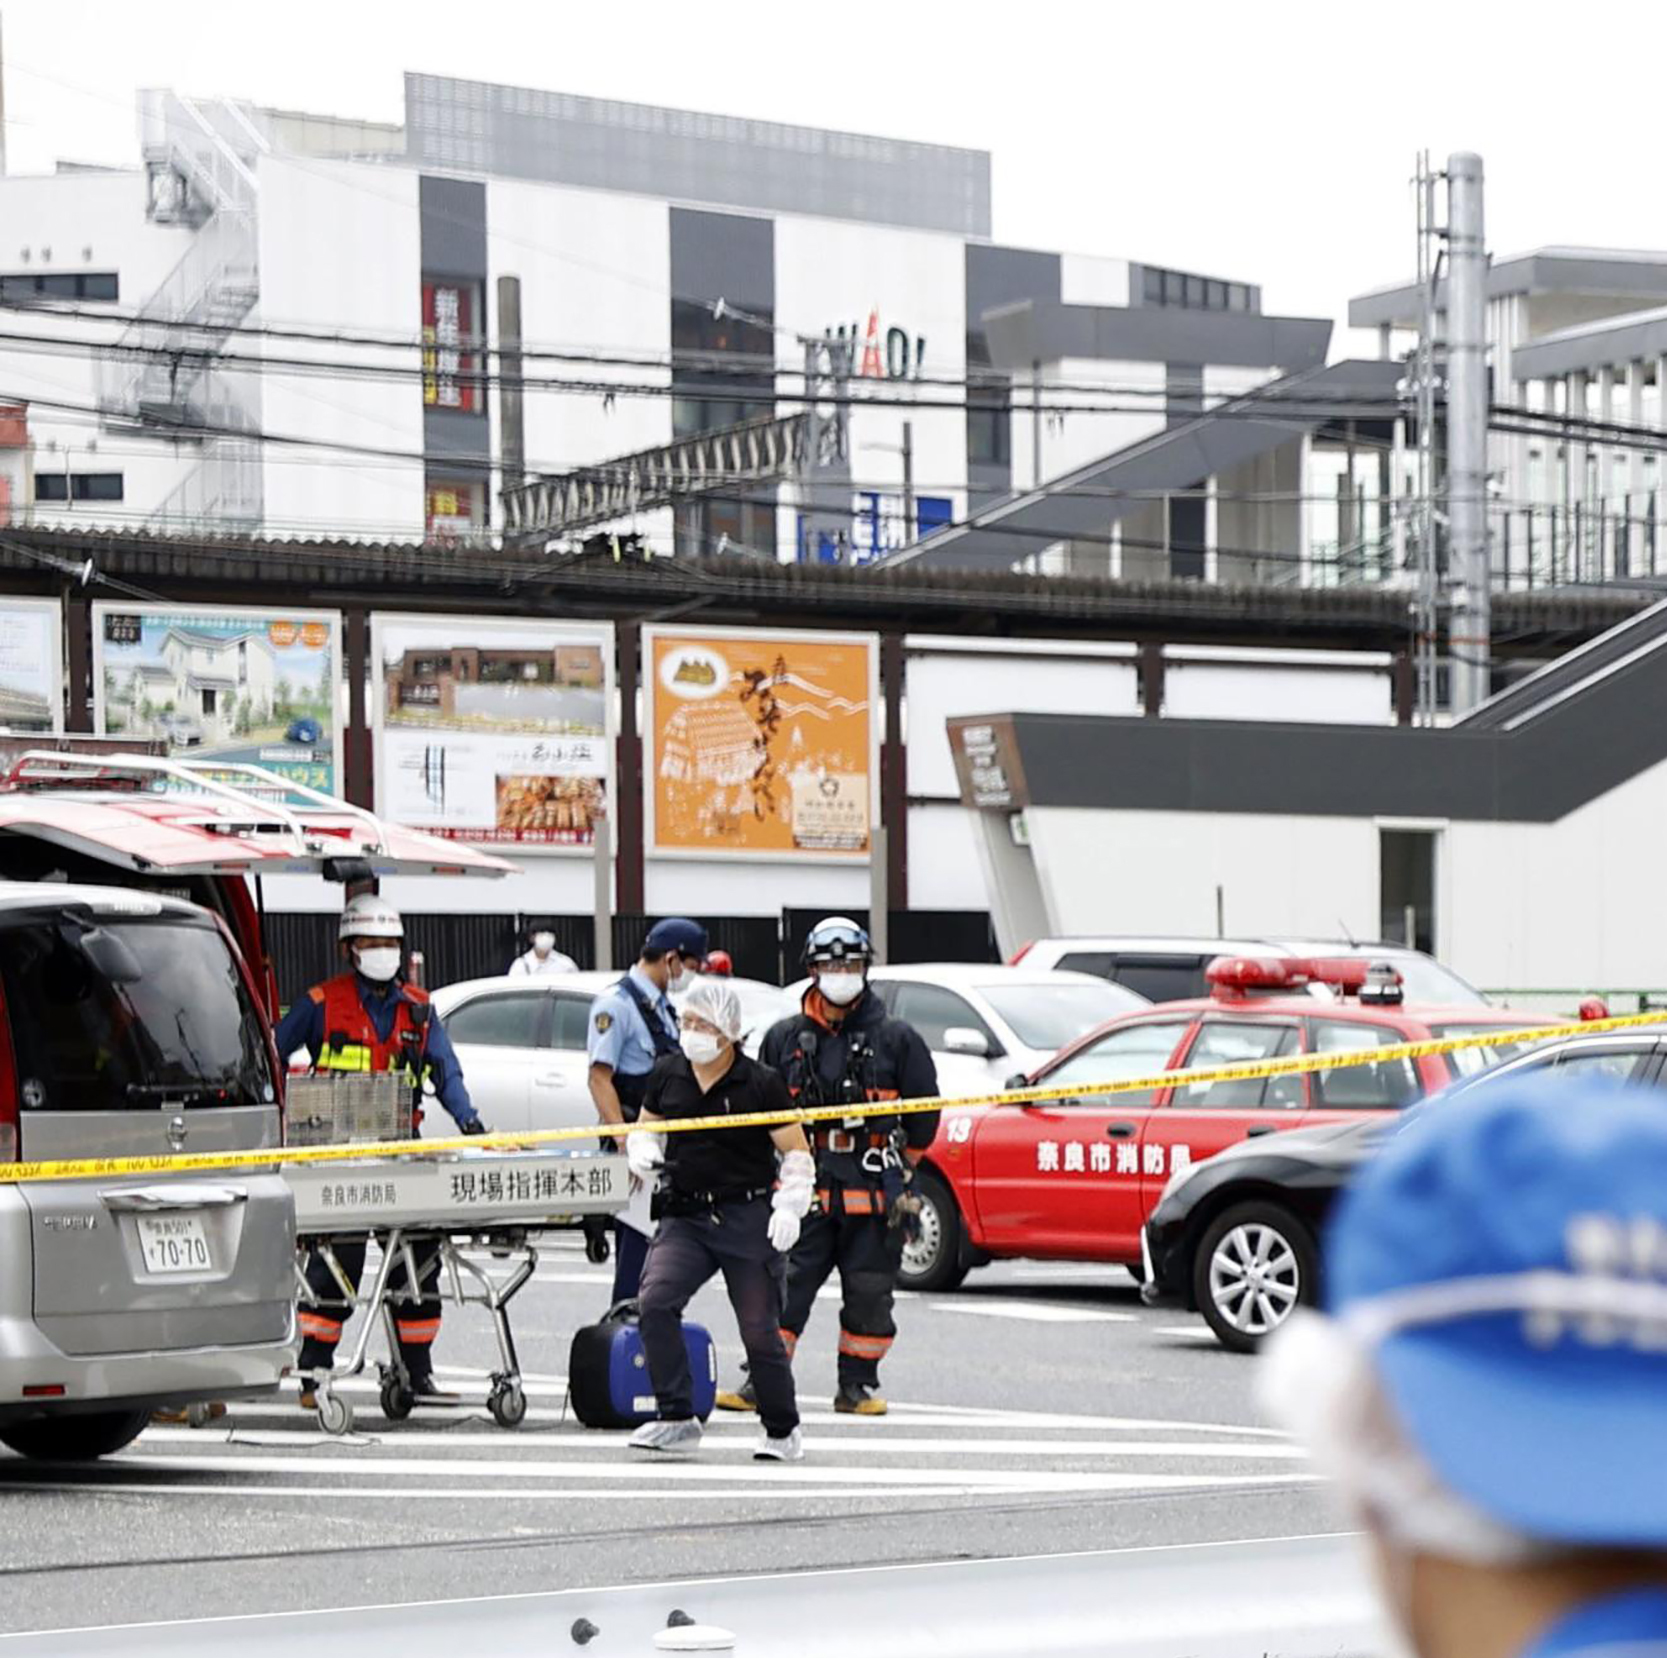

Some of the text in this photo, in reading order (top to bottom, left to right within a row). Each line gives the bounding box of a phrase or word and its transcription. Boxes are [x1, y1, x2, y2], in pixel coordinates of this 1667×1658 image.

[1037, 1141, 1192, 1174] 奈良市消防局
[321, 1167, 612, 1206] 奈良市消防局 現場指揮本部
